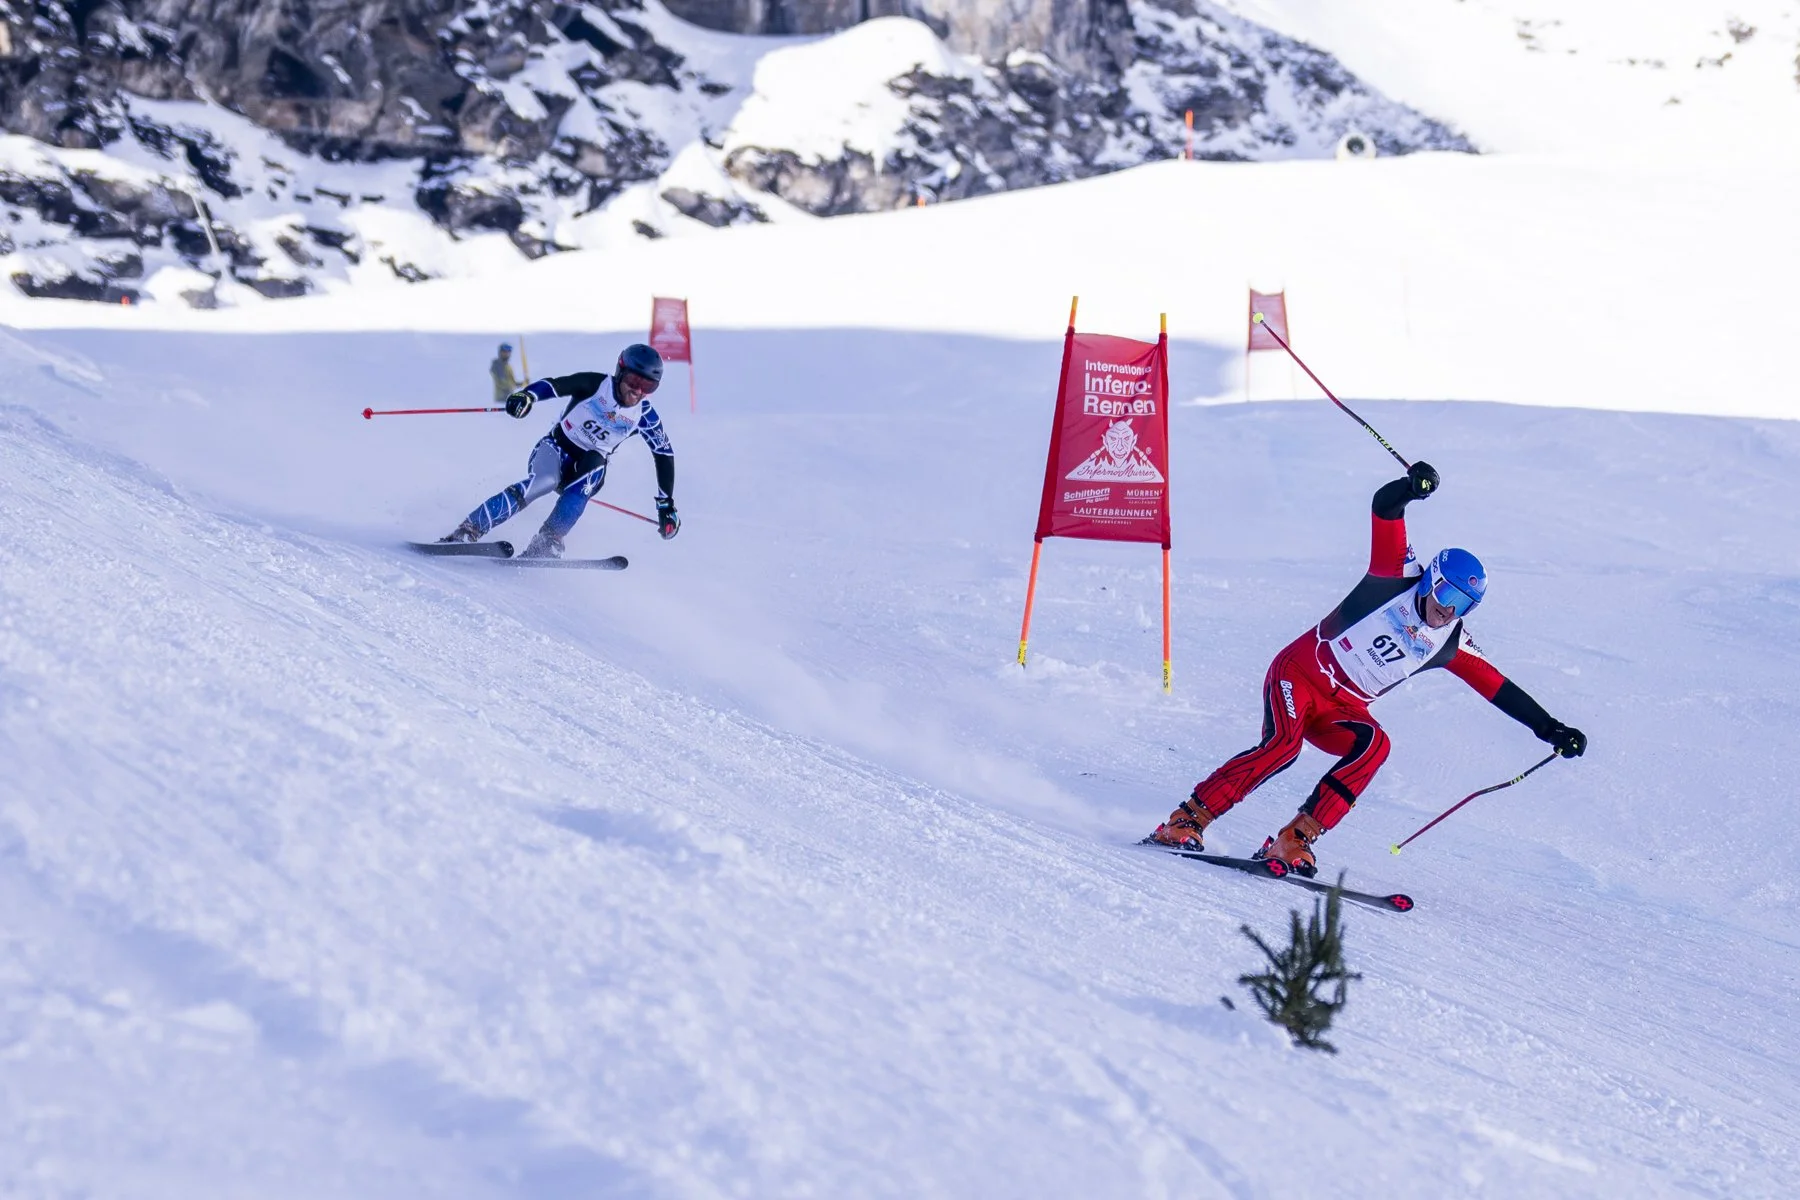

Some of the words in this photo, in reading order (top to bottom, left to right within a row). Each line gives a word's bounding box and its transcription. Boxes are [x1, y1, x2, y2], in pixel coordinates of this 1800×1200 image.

[1083, 395, 1156, 415] Rennen
[583, 419, 610, 441] 615
[1063, 487, 1110, 500] Schilthorn
[1366, 647, 1386, 668] AUGUST
[1373, 634, 1406, 664] 617
